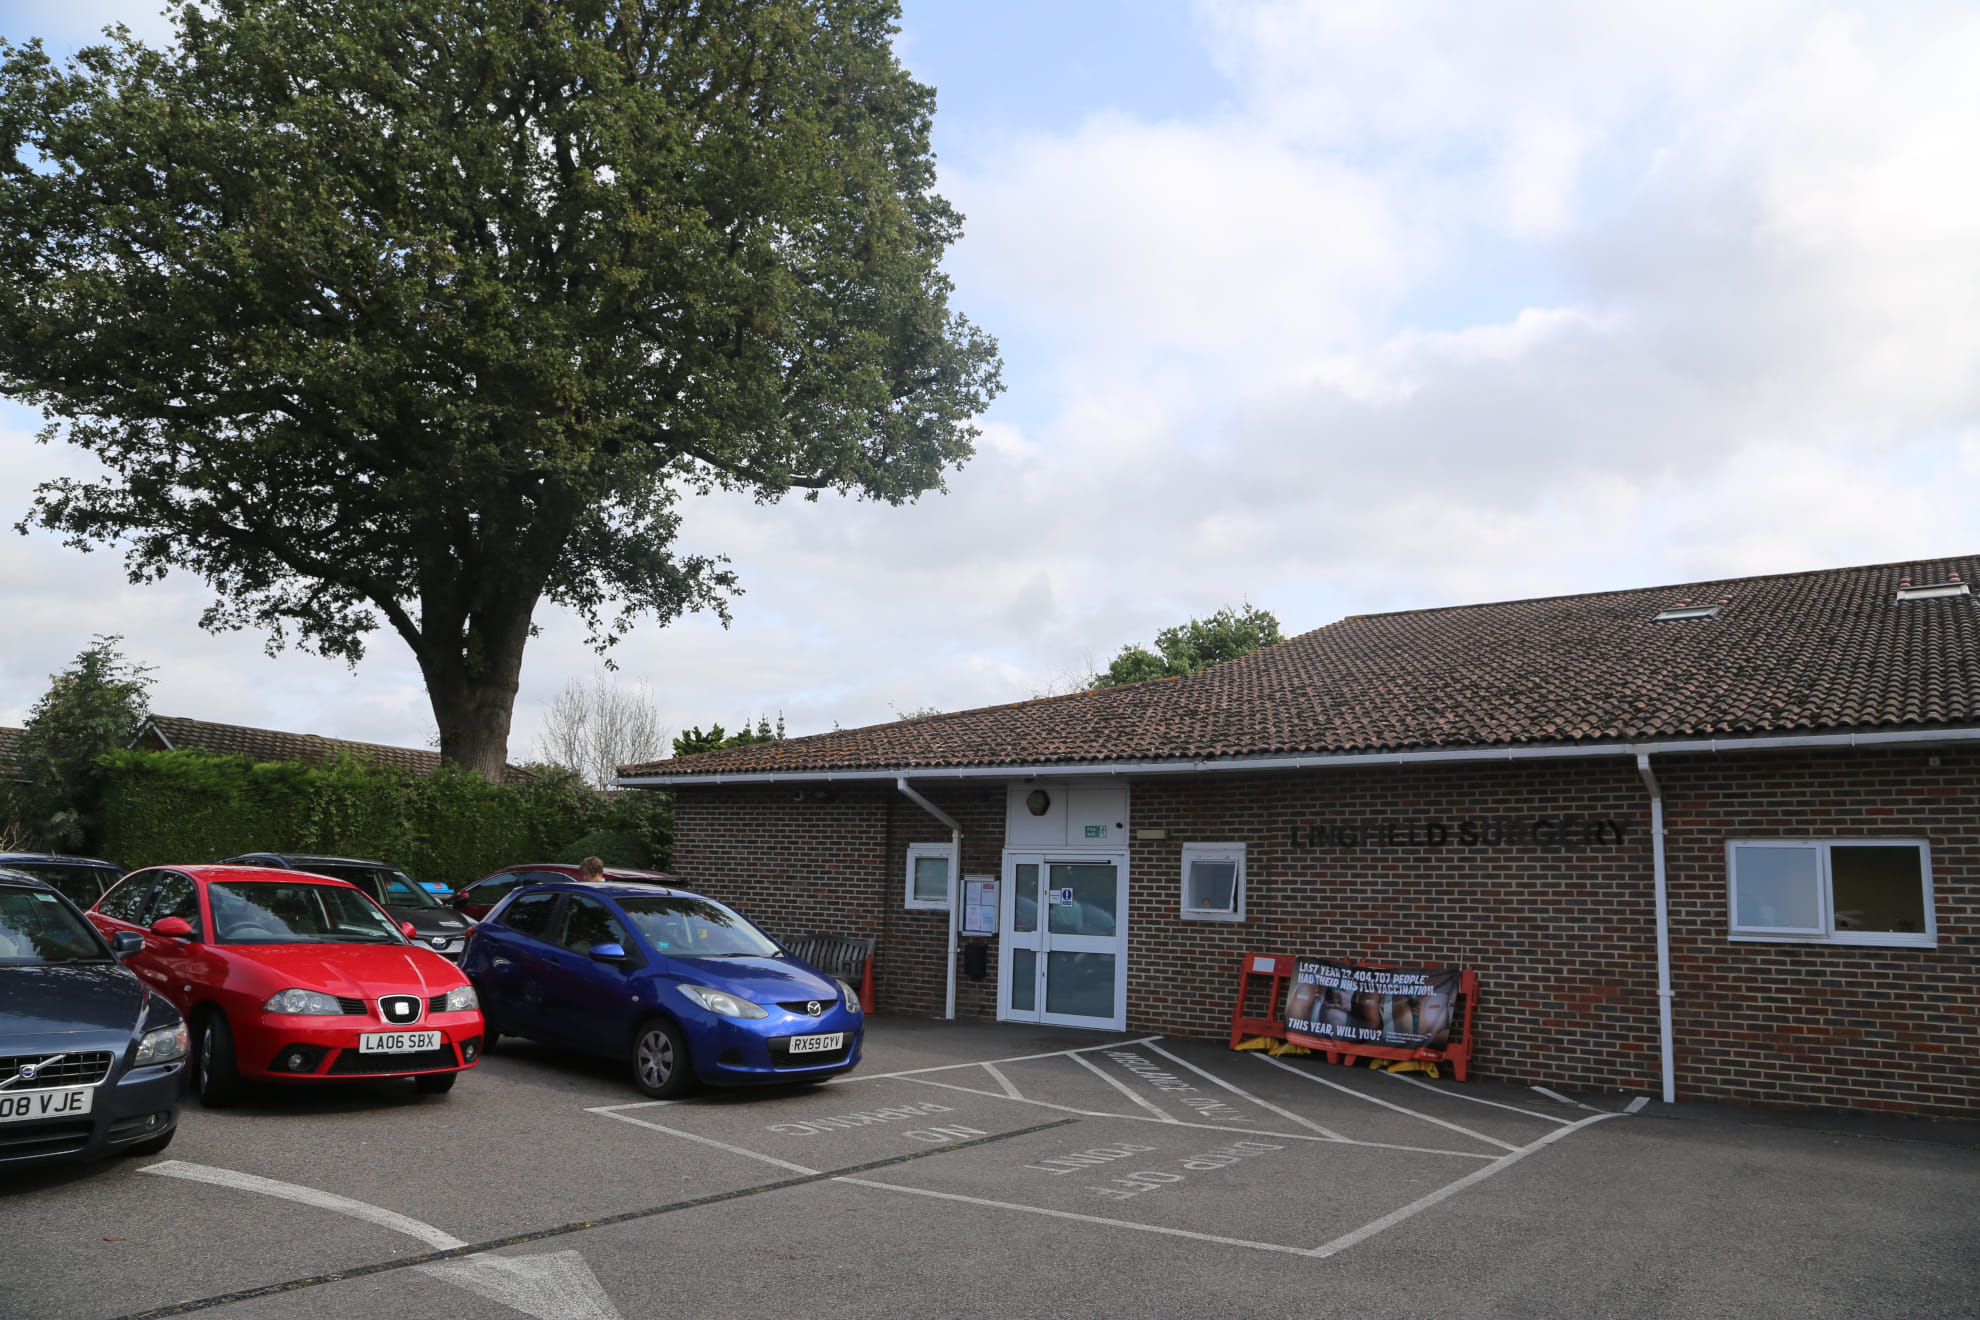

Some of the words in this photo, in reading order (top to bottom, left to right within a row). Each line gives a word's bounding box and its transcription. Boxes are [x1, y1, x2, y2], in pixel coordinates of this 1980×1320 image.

[1290, 823, 1448, 848] LINGFIELD
[1457, 819, 1631, 847] SURGERY
[1299, 961, 1320, 974] LAST
[1320, 965, 1341, 979] YEAR
[1298, 972, 1315, 985] HAD
[1315, 974, 1340, 988] THEIR
[1340, 977, 1358, 991] NHS
[1359, 982, 1375, 993] FLU
[1376, 983, 1437, 997] VACCINATION.
[1288, 1017, 1309, 1031] THIS
[1310, 1022, 1334, 1037] YEAR,
[1336, 1025, 1356, 1039] WILL
[1359, 1028, 1382, 1041] YOU?
[365, 1035, 404, 1050] LA06
[408, 1033, 434, 1048] SBX
[794, 1037, 821, 1051] RX59
[822, 1035, 840, 1049] GYV
[40, 1091, 84, 1114] VJE
[765, 1102, 955, 1136] PARKING
[903, 1123, 988, 1143] NO
